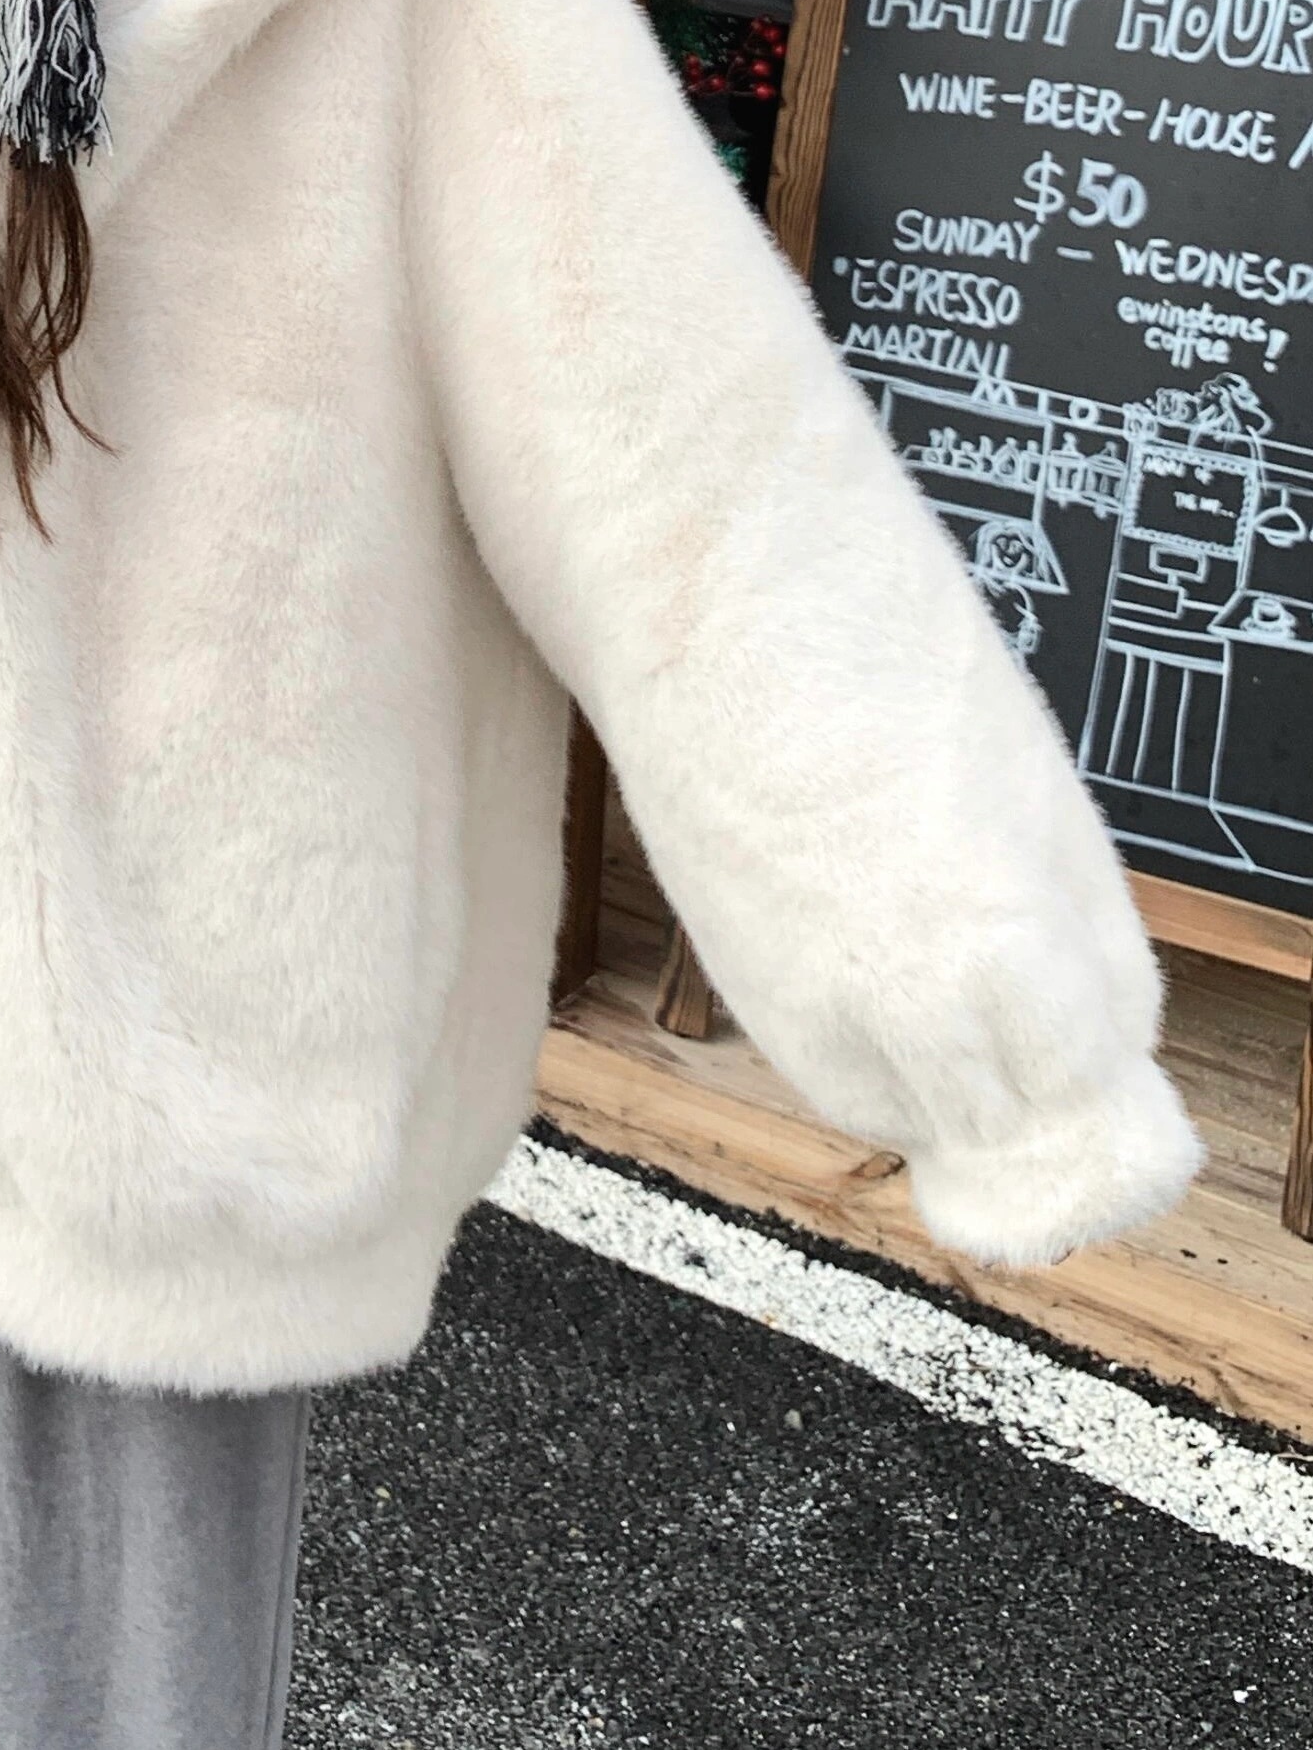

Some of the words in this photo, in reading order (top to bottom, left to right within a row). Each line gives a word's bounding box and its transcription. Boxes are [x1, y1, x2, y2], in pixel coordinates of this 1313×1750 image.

[1013, 150, 1148, 229] $50
[851, 257, 1021, 329] ESPRESSO
[892, 209, 1041, 264] SUNDAY
[1114, 238, 1313, 306] WEDNESD
[844, 322, 1009, 379] MARTINI
